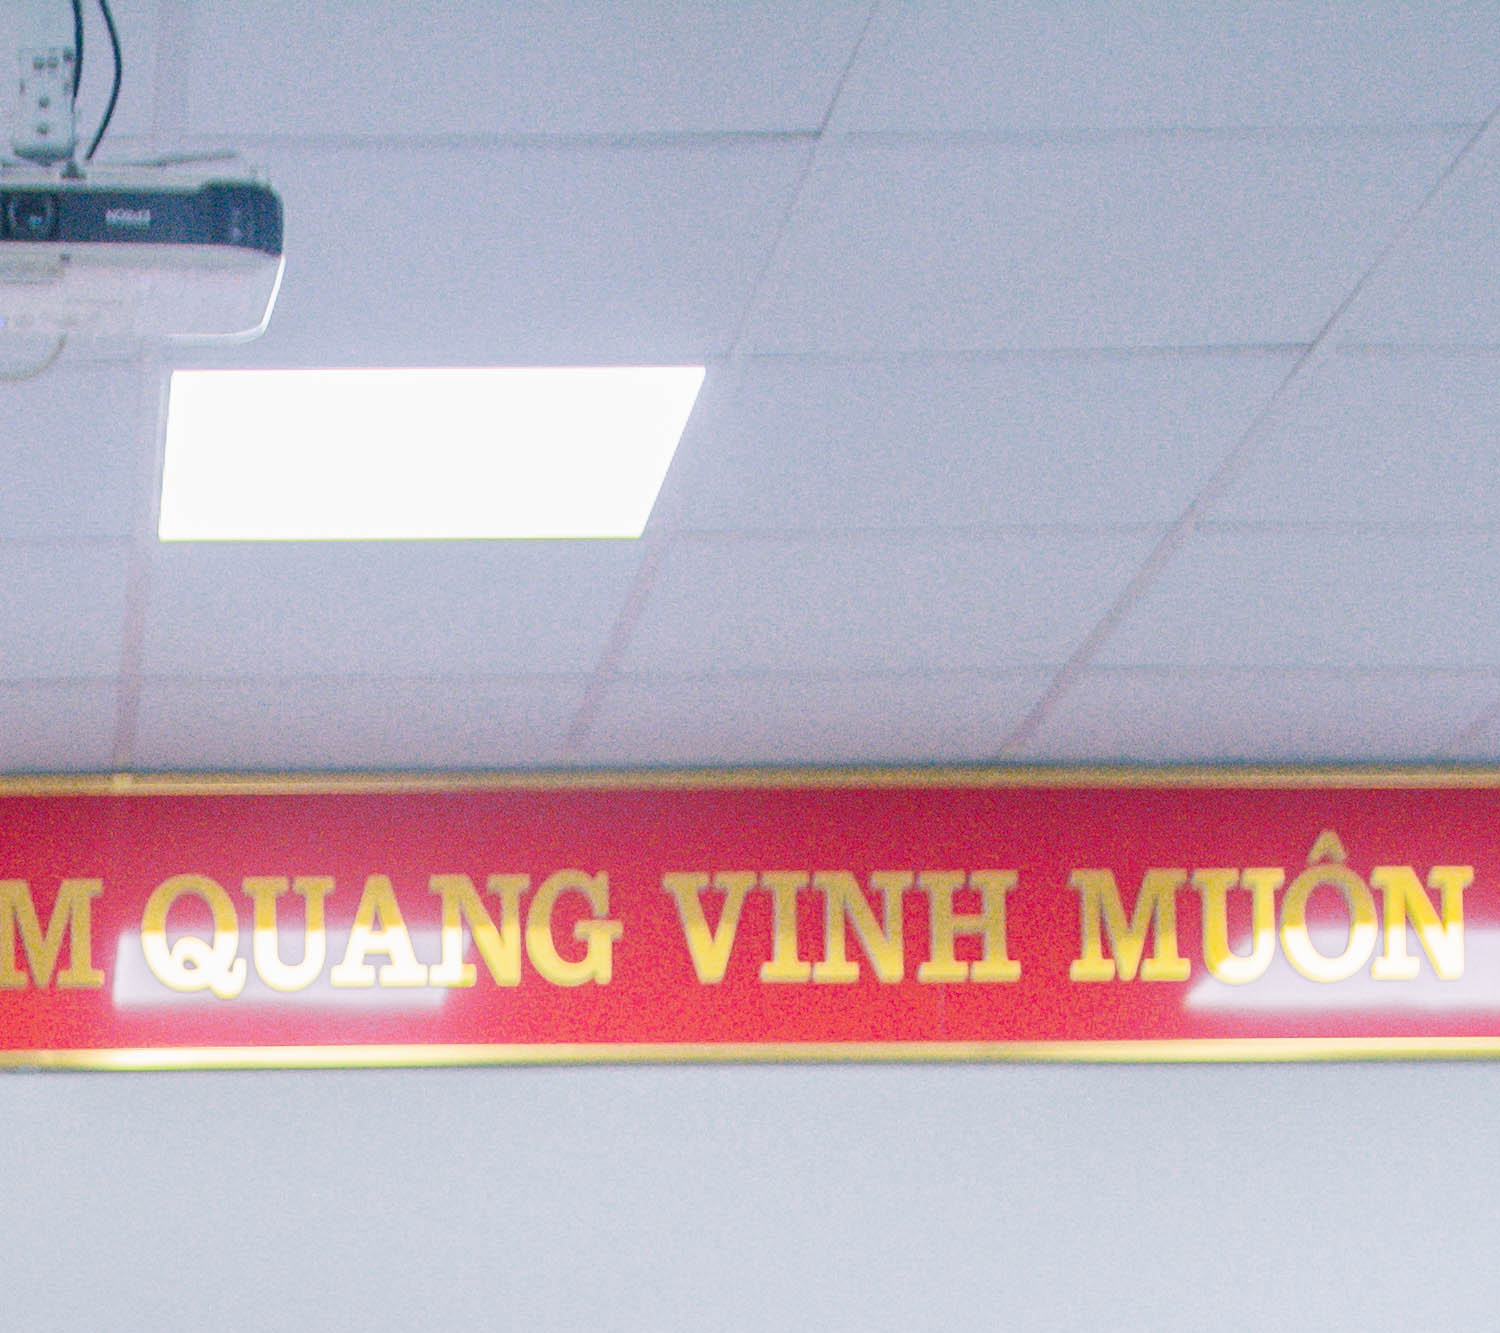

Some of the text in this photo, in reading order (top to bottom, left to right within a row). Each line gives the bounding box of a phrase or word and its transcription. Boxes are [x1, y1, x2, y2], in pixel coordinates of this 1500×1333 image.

[140, 869, 624, 999] QUANG
[662, 869, 1022, 986] VINH
[1069, 829, 1475, 986] MUÔN
